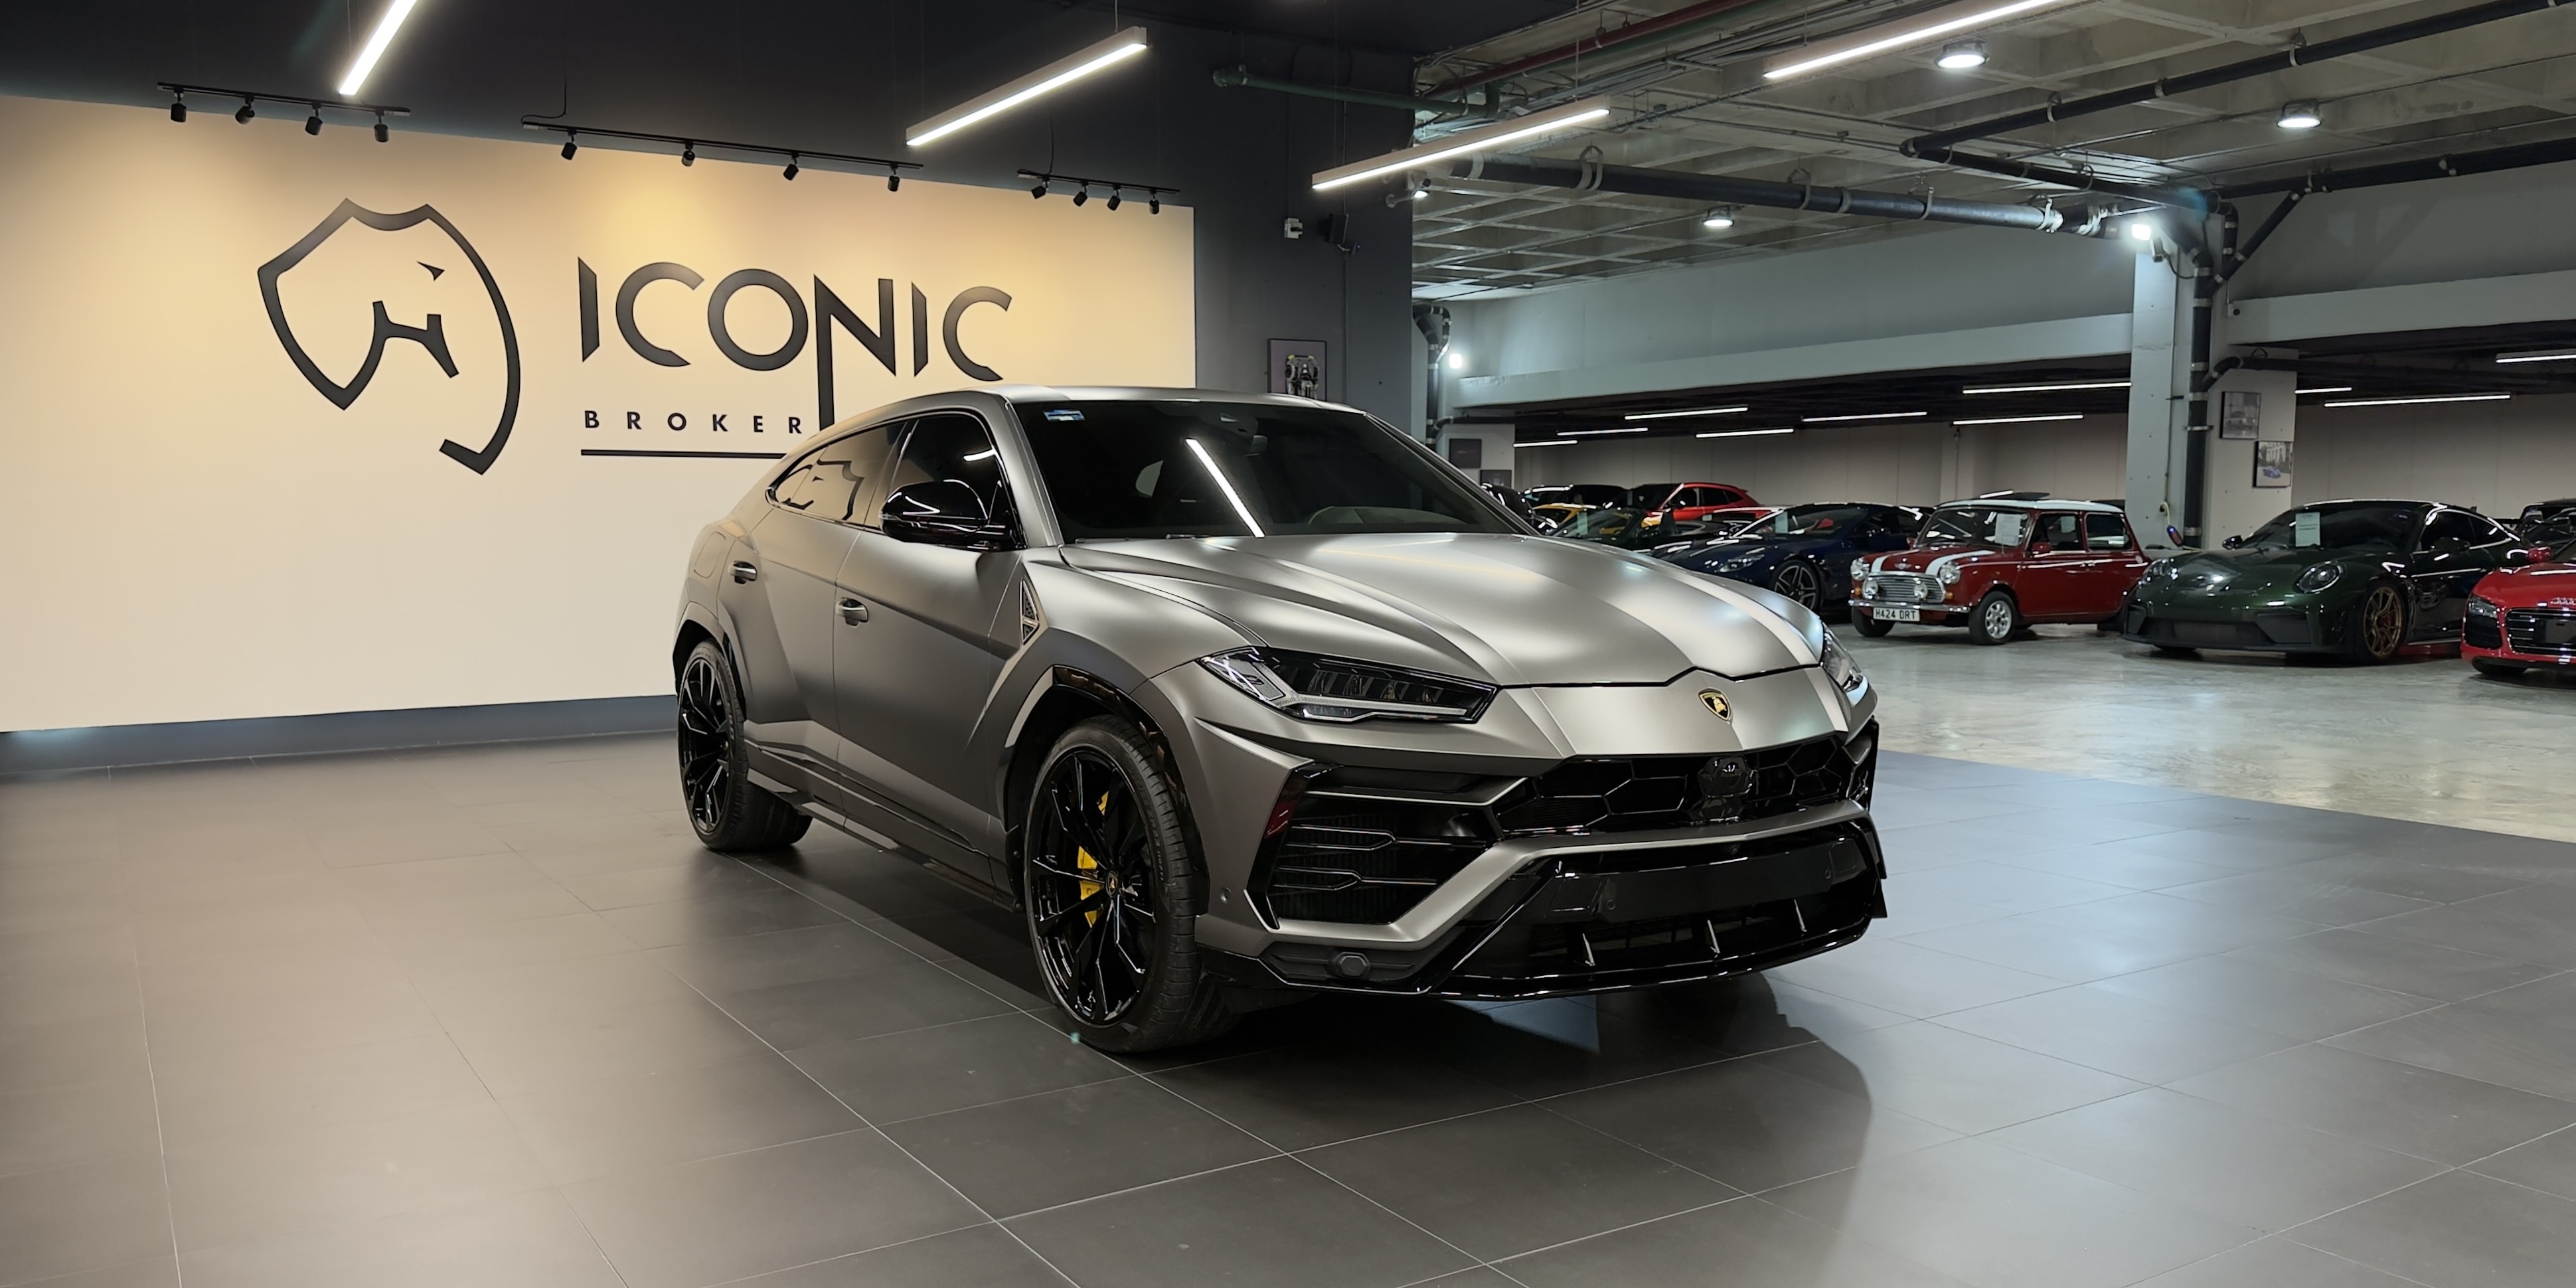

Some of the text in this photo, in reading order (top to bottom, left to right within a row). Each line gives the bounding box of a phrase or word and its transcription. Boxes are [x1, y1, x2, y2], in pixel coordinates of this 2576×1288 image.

[576, 256, 1013, 432] ICONIC
[1875, 608, 1916, 620] H424 DRT
